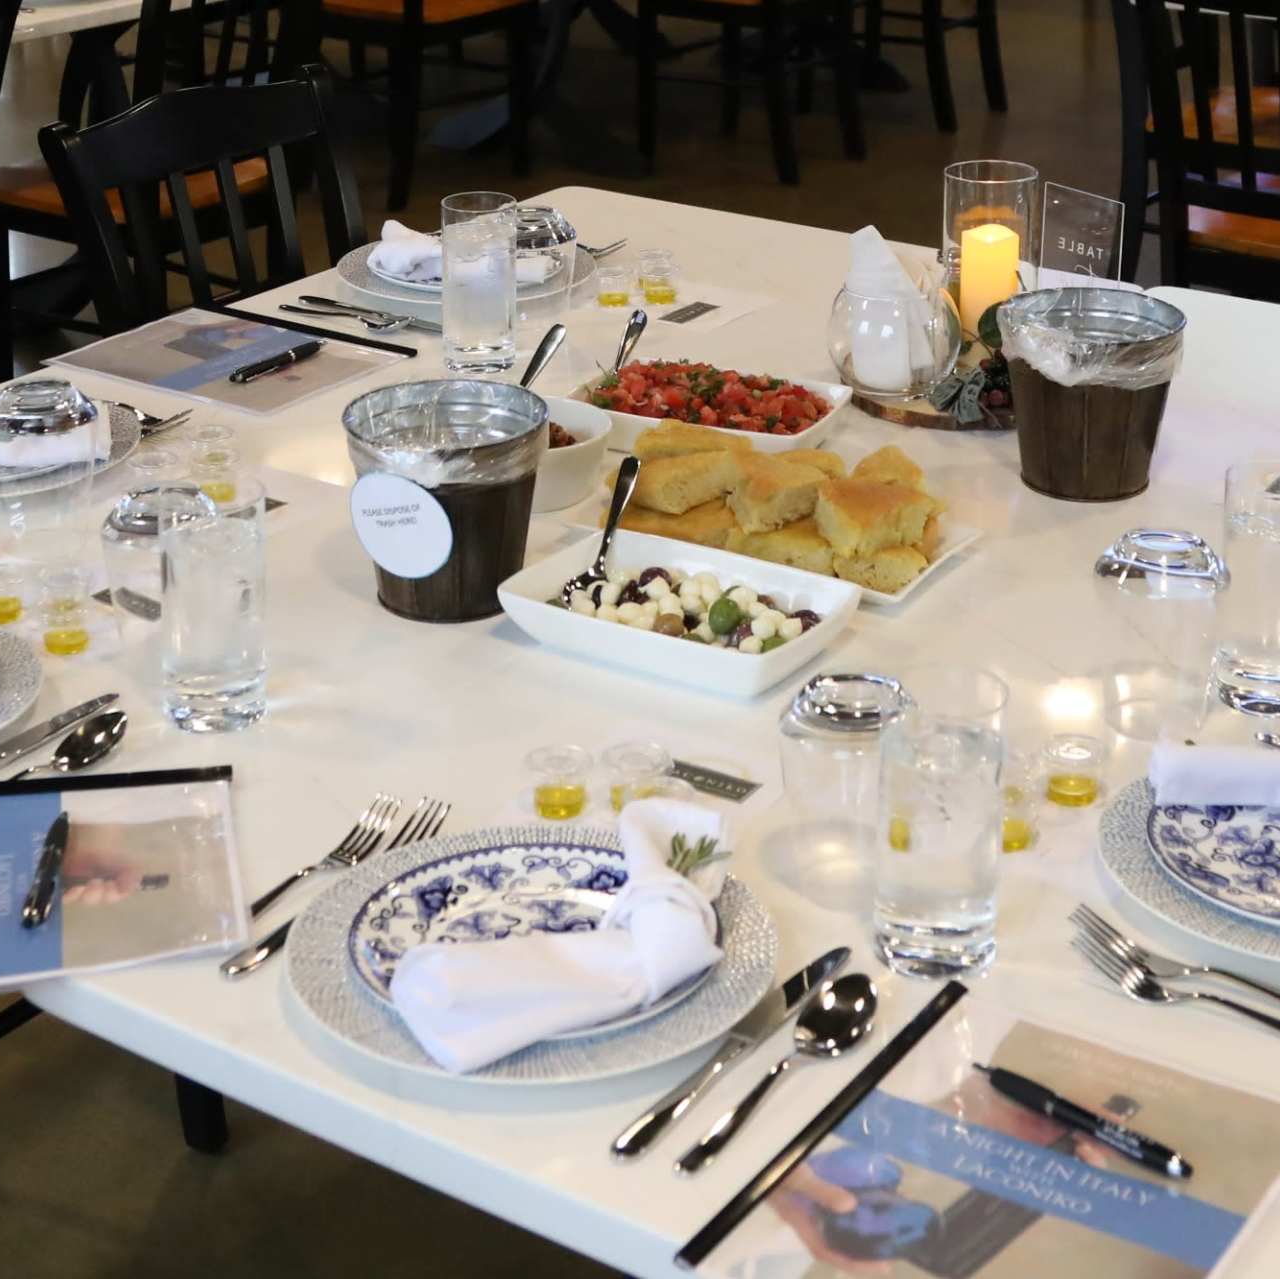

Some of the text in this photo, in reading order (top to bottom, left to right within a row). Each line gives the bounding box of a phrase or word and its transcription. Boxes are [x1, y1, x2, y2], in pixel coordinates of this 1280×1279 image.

[411, 504, 420, 512] OF
[953, 1126, 1036, 1169] NIGHT
[1042, 1159, 1075, 1182] IN
[1077, 1170, 1158, 1208] ITALY
[953, 1152, 1093, 1214] LACONIKO
